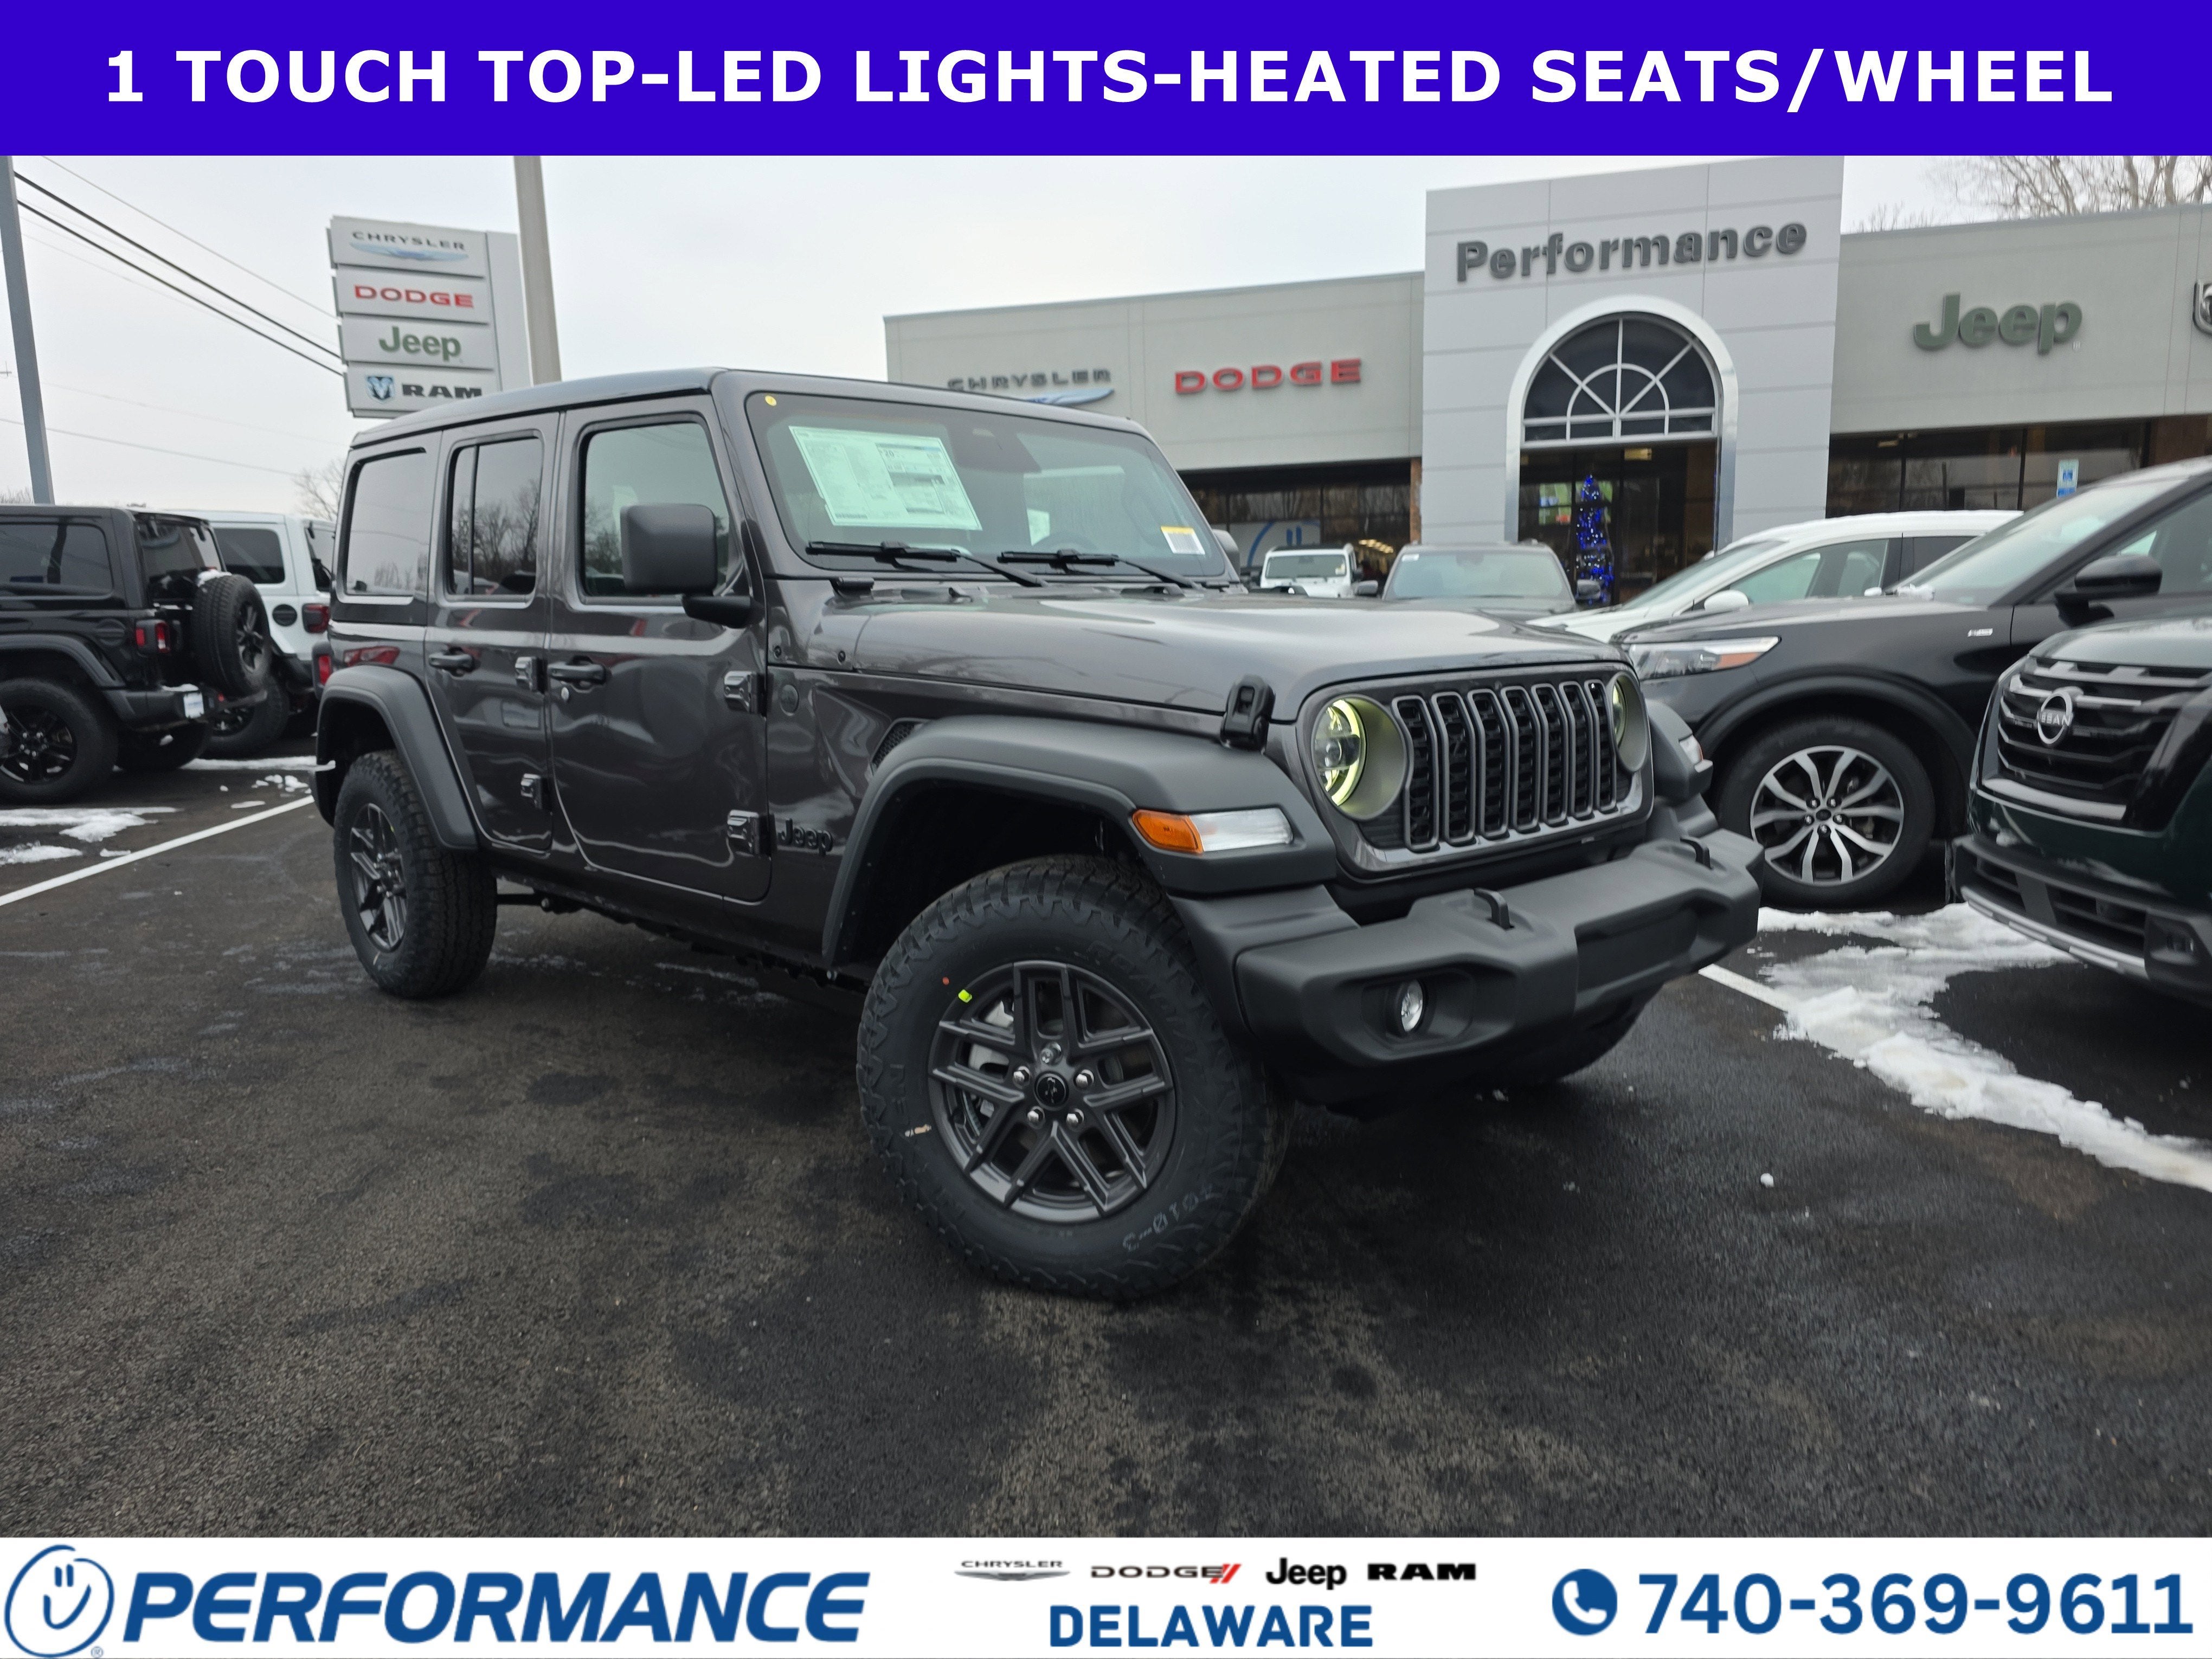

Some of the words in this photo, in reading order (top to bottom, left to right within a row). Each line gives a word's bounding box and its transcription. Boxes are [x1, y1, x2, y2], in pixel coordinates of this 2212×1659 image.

[352, 231, 465, 250] CHRYSLER
[1456, 222, 1807, 282] Performance
[354, 285, 474, 308] DODGE
[1913, 293, 2083, 356] Jeep
[379, 326, 461, 361] Jeep
[402, 383, 482, 400] RAM
[948, 368, 1111, 391] CHRYSLER
[1174, 358, 1362, 395] DODGE
[777, 818, 833, 857] Jeep
